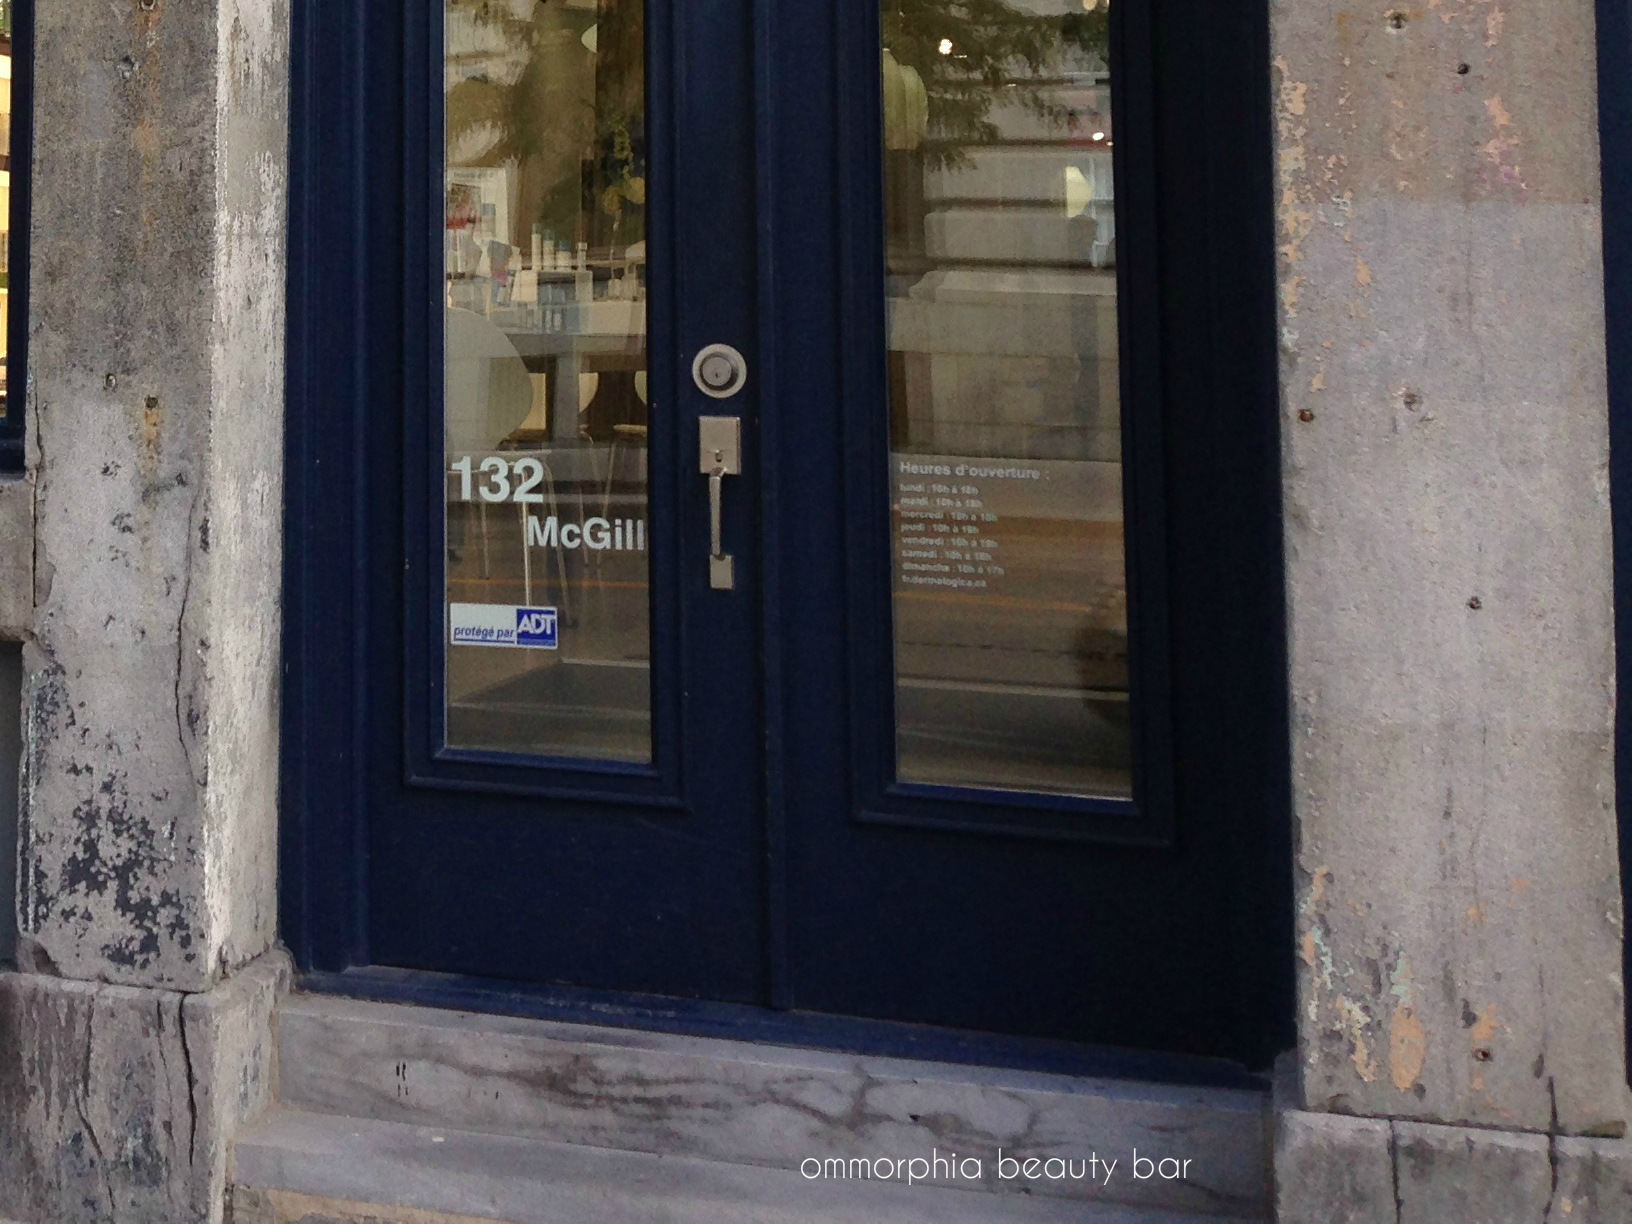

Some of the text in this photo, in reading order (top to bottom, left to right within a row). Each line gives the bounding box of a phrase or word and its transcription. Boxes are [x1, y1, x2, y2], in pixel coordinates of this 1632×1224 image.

[451, 455, 544, 503] 132
[899, 461, 1040, 479] Heures d'ouverture
[527, 515, 644, 551] McGill
[454, 613, 554, 642] protégé par ADT
